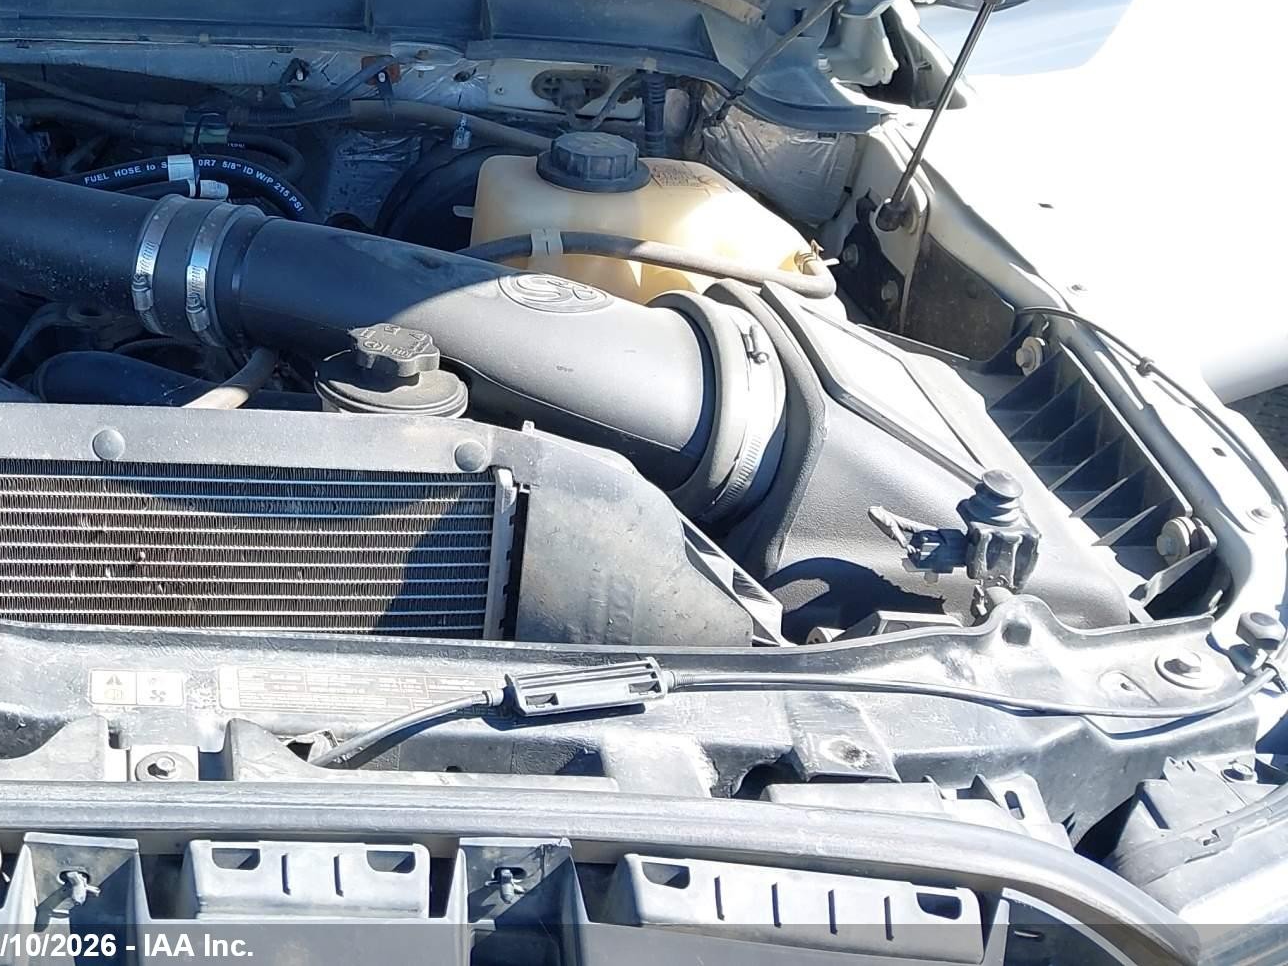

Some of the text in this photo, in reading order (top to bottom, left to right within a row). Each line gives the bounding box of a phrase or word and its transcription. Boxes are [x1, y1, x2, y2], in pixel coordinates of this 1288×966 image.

[84, 173, 110, 185] FUEL
[114, 165, 142, 177] HOSE
[146, 162, 156, 171] to
[242, 165, 254, 175] ID
[255, 170, 274, 184] W/P
[288, 195, 305, 212] PSI
